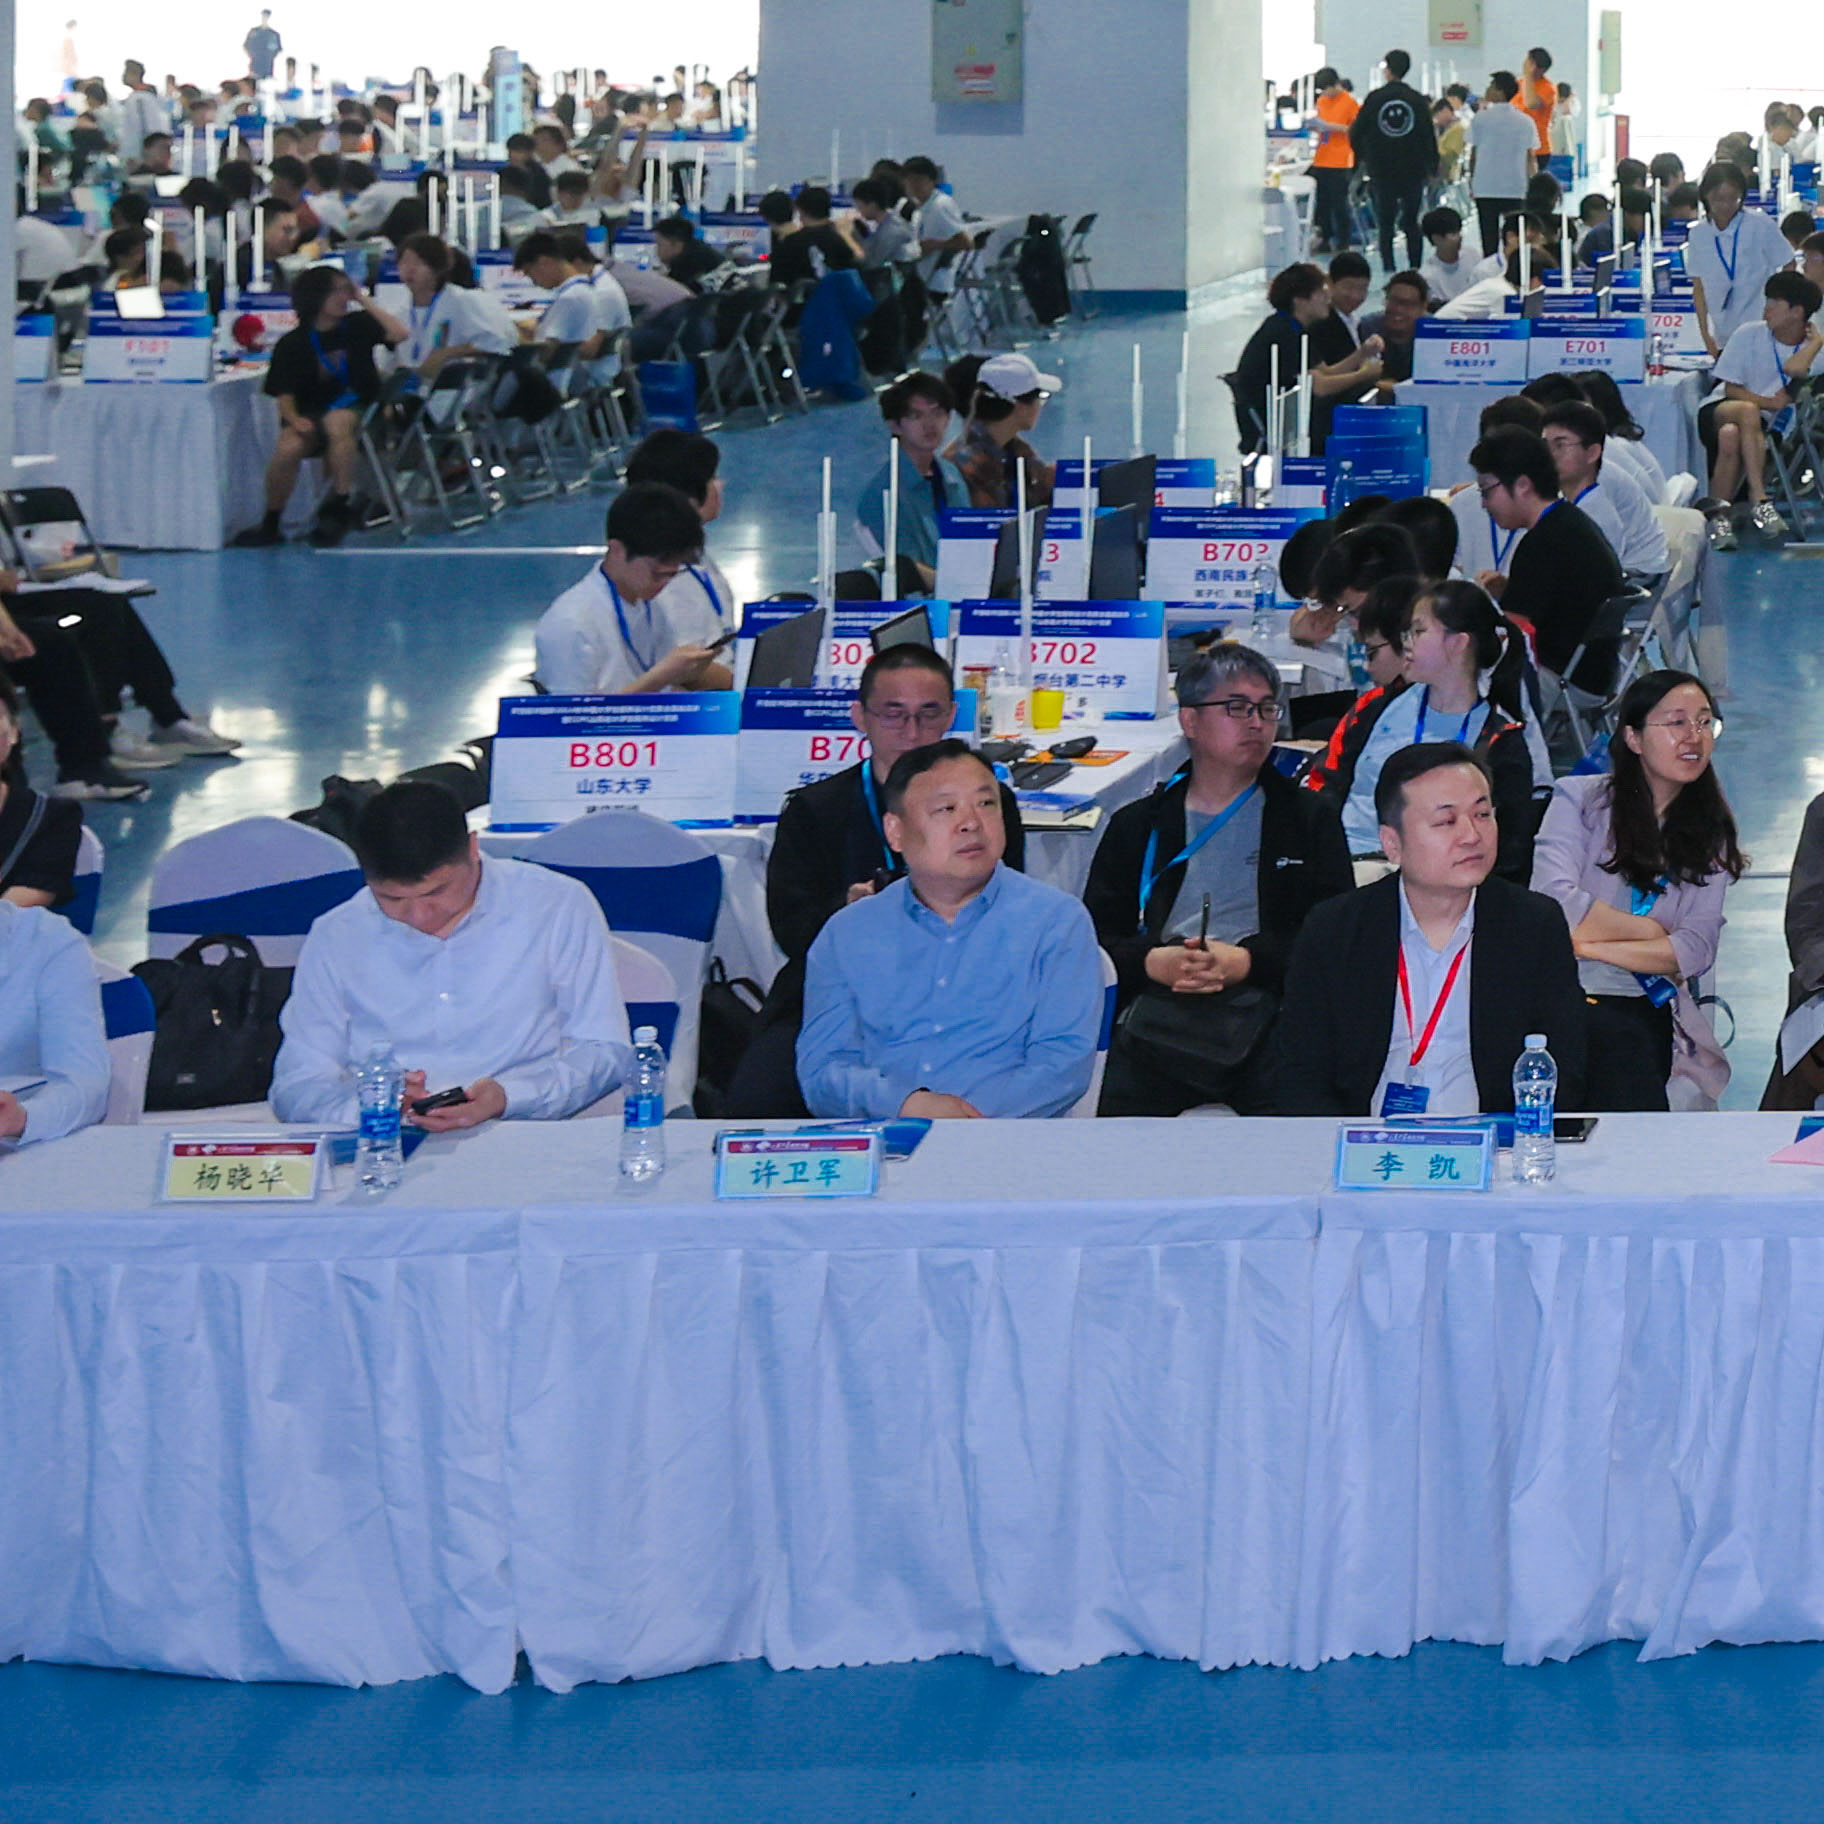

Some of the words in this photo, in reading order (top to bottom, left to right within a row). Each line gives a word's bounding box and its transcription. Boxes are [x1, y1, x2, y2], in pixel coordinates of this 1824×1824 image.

[1654, 315, 1684, 328] 702
[1450, 341, 1491, 355] E801
[1565, 340, 1607, 354] E701
[568, 741, 658, 769] B801
[576, 778, 653, 795] 山东大学
[192, 1161, 284, 1193] 杨晓华
[750, 1156, 843, 1188] 许卫军
